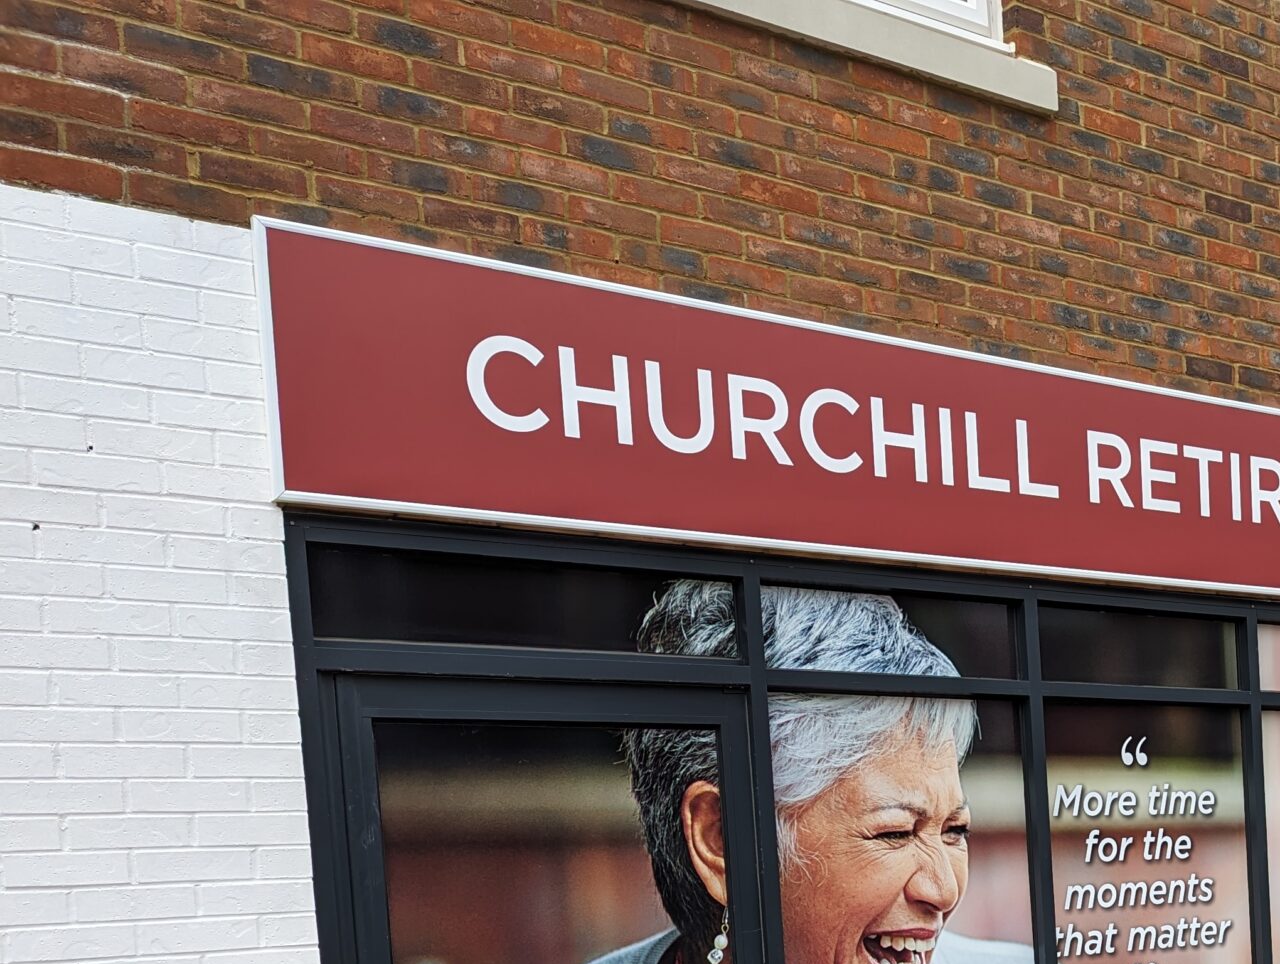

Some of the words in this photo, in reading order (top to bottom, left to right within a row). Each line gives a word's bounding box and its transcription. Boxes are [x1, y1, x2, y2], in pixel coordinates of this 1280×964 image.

[466, 334, 1060, 498] CHURCHILL
[1053, 784, 1138, 817] More
[1148, 783, 1216, 816] time
[1084, 829, 1133, 863] for
[1143, 828, 1193, 861] the
[1064, 873, 1214, 910] moments
[1056, 923, 1118, 957] that
[1127, 916, 1232, 952] matter
